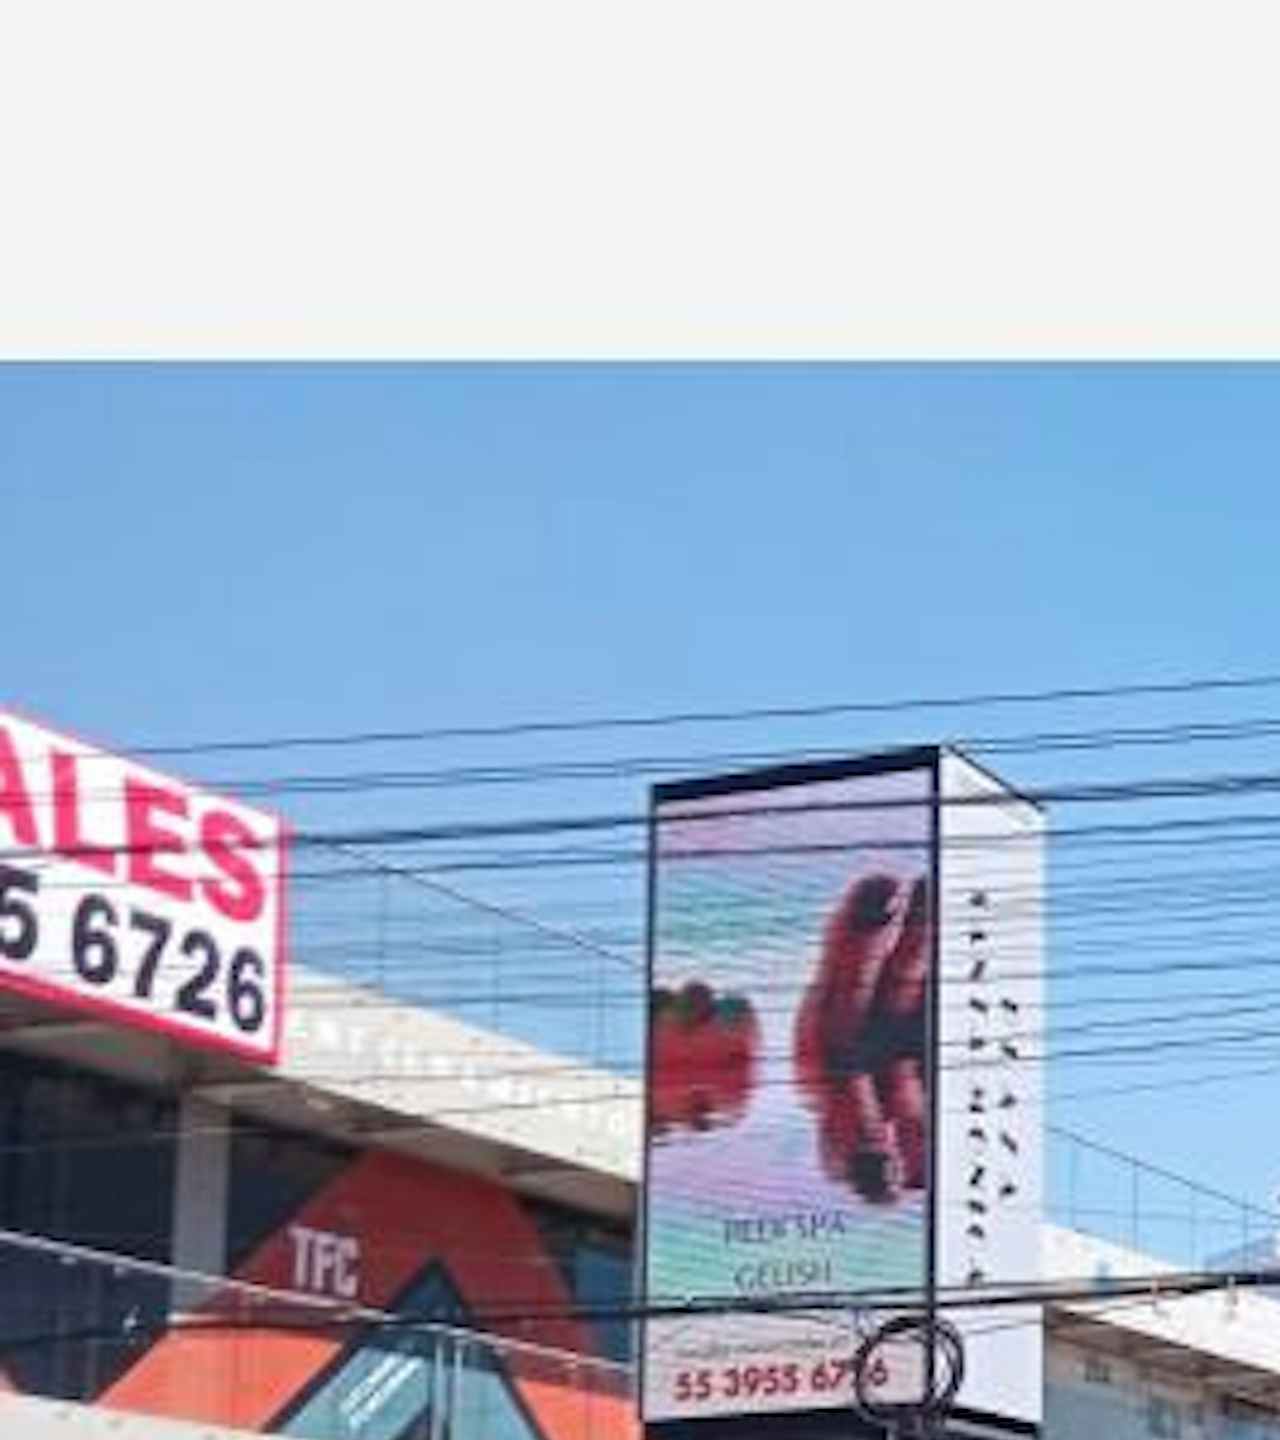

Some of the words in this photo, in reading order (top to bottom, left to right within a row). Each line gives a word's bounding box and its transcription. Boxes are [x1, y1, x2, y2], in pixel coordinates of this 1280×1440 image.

[72, 893, 265, 1033] 6726
[288, 1222, 362, 1298] TFC
[675, 1371, 712, 1402] 55
[722, 1364, 799, 1397] 3955
